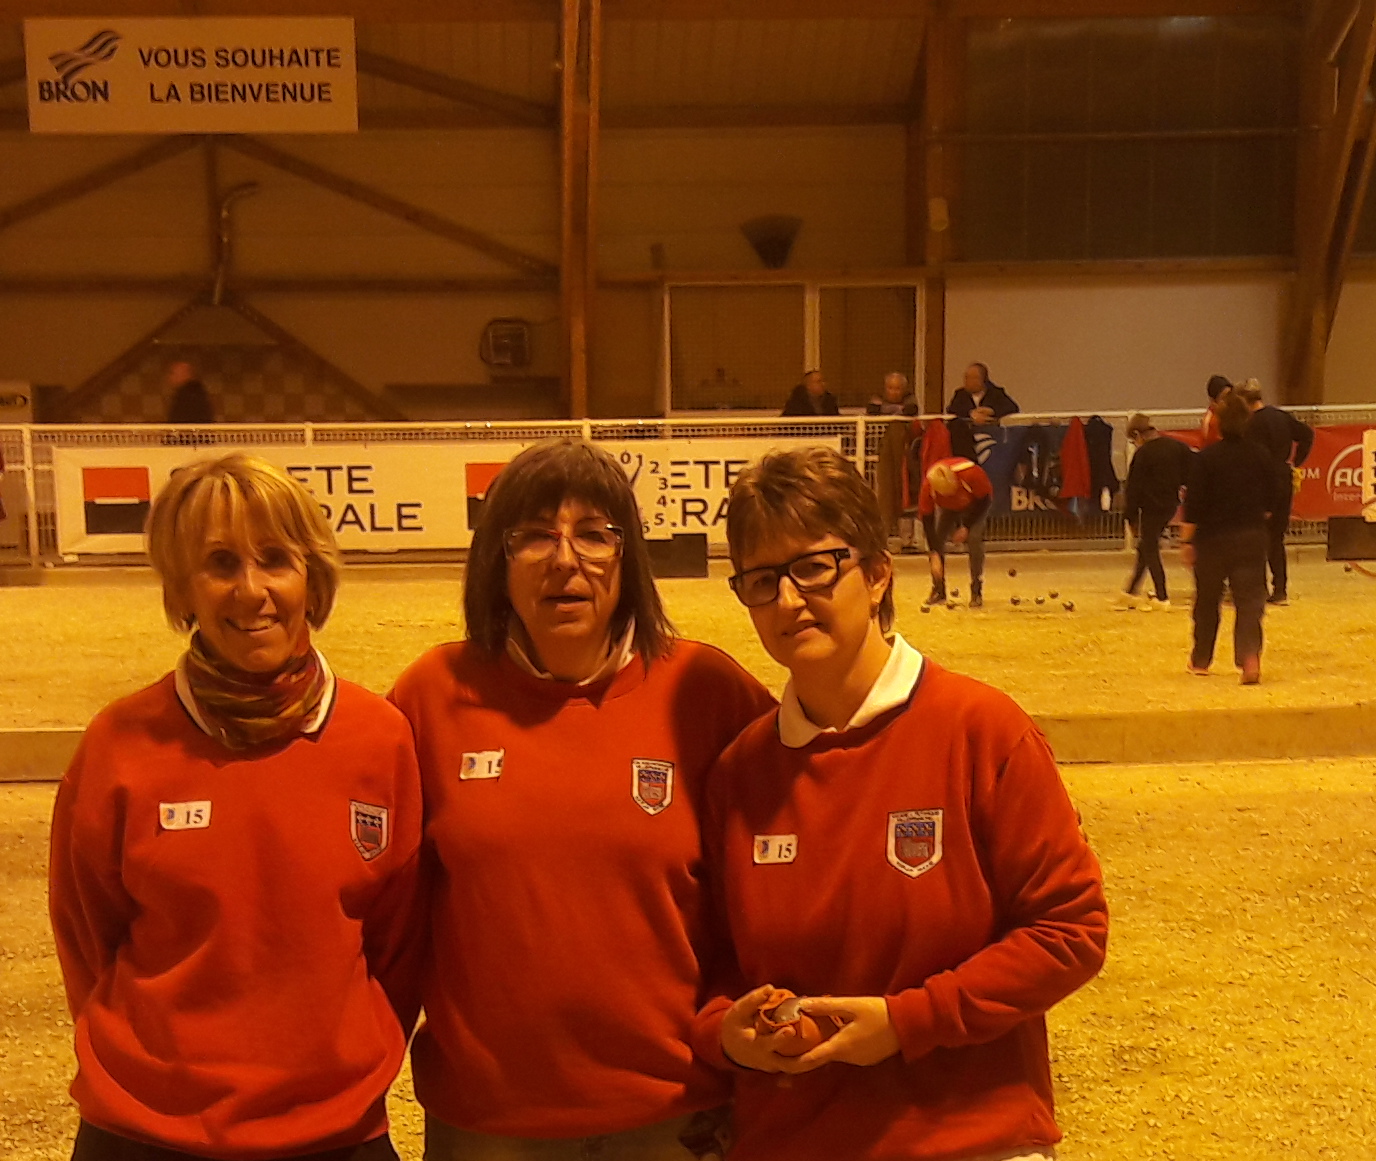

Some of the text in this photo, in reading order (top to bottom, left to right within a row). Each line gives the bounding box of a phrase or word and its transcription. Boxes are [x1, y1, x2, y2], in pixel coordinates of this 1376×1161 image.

[138, 48, 342, 69] VOUS SOUHAITE
[38, 79, 110, 103] BRON
[149, 82, 333, 104] LA BIENVENUE
[620, 450, 631, 464] 0
[650, 461, 661, 474] 2
[658, 477, 669, 490] 3
[656, 495, 667, 508] 4
[654, 513, 665, 526] 5
[185, 809, 204, 825] 15
[777, 843, 793, 859] 15
